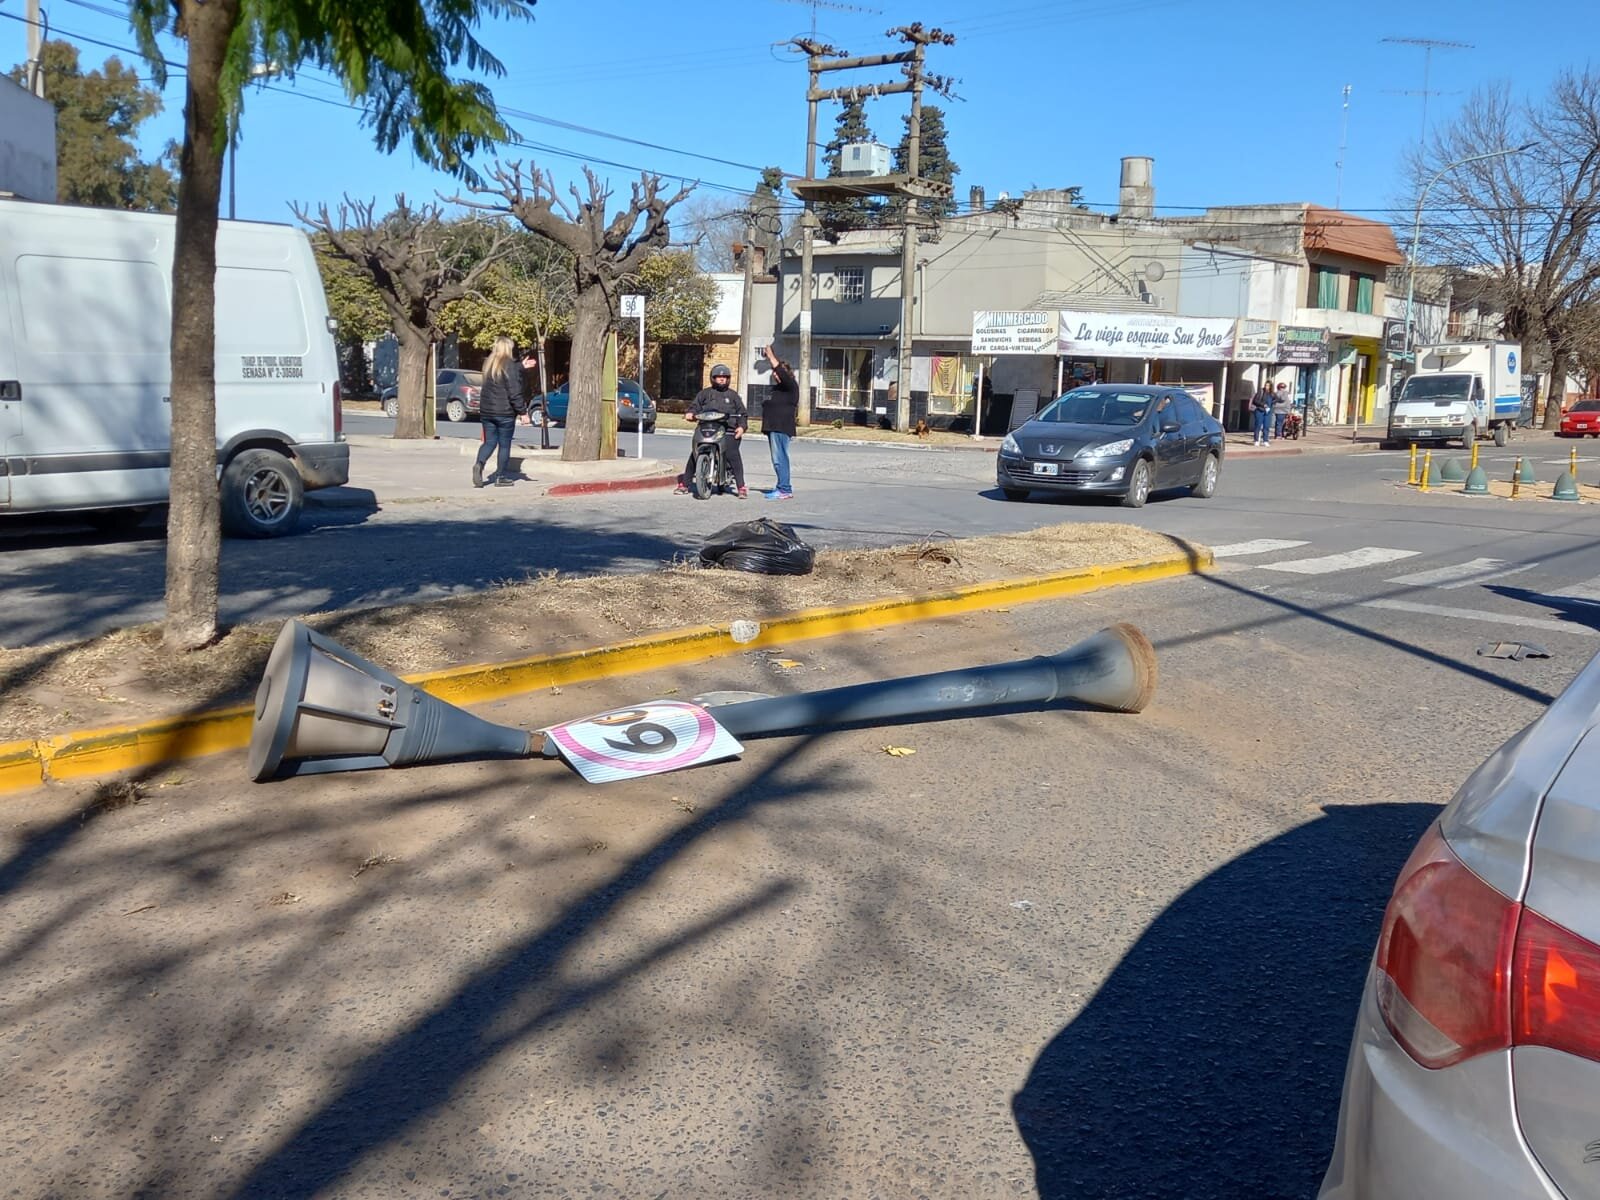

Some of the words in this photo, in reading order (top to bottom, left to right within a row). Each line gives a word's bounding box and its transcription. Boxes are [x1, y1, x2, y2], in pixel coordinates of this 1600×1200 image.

[986, 311, 1048, 327] MINIMERCADO
[1074, 322, 1092, 340] La
[1095, 326, 1124, 346] vieja
[1126, 328, 1169, 347] esquina
[1172, 327, 1195, 345] San
[1196, 327, 1223, 348] Jose
[242, 367, 267, 378] SENASA
